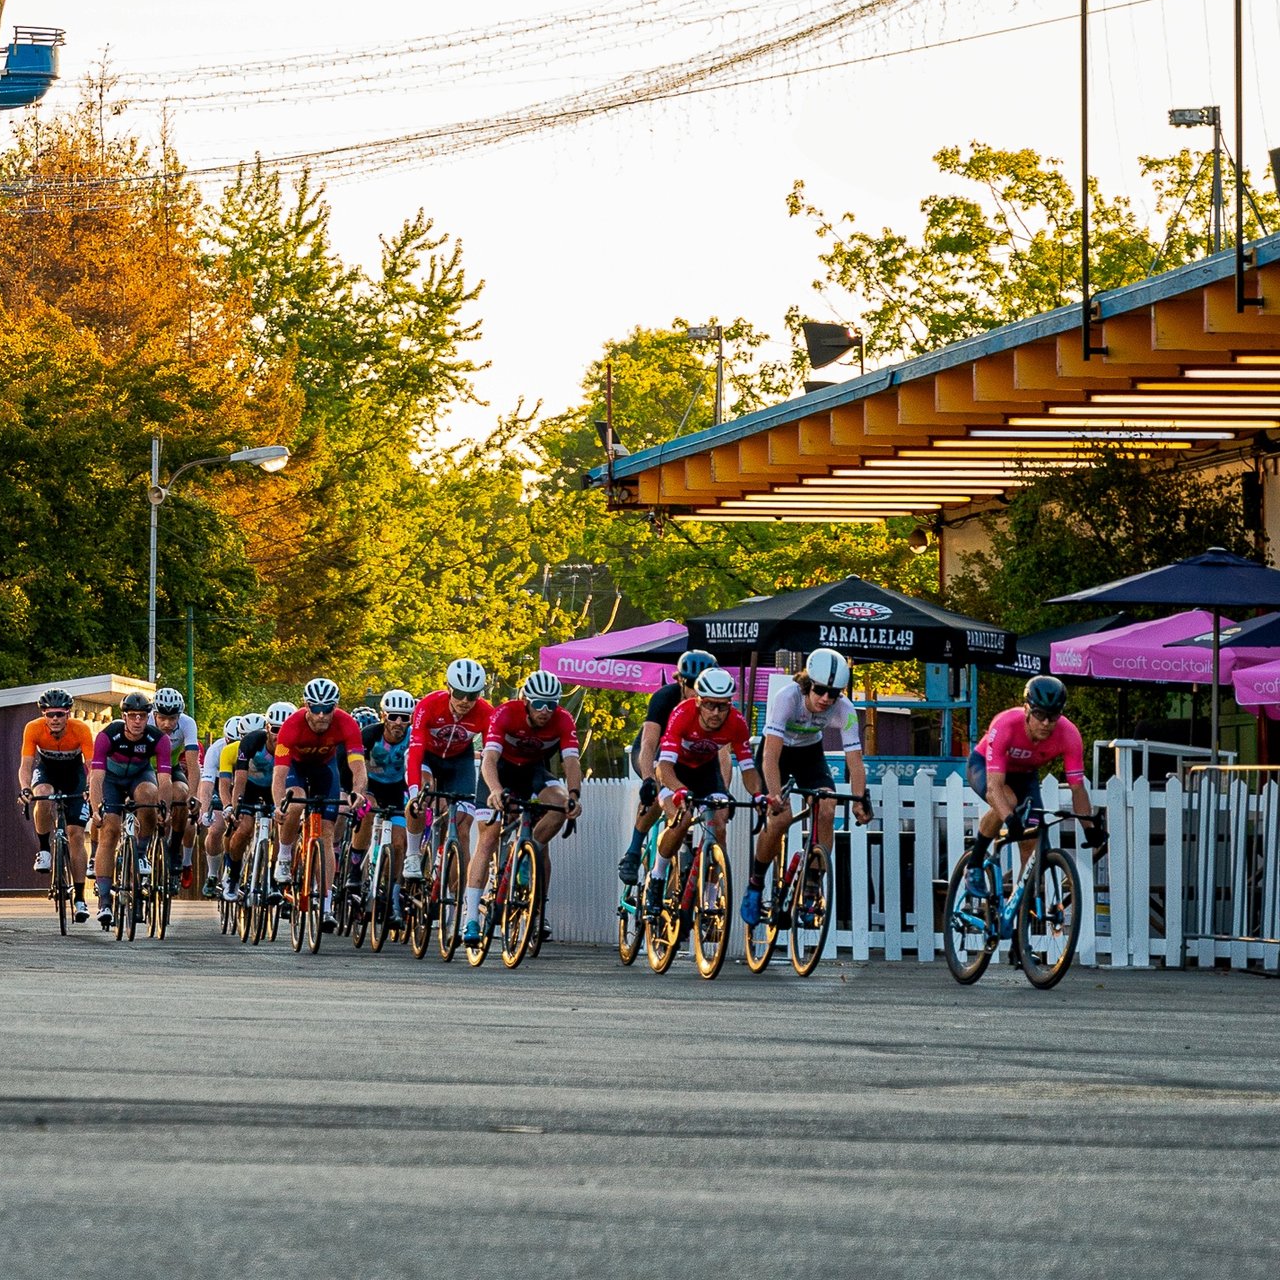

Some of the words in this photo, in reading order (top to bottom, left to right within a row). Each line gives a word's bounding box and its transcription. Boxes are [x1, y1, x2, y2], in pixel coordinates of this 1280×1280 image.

[705, 622, 759, 638] PARALLEL49
[819, 625, 914, 646] PARALLEL49
[966, 630, 1005, 650] PARALLEL49
[557, 657, 642, 679] muddlers
[1112, 656, 1148, 669] craft
